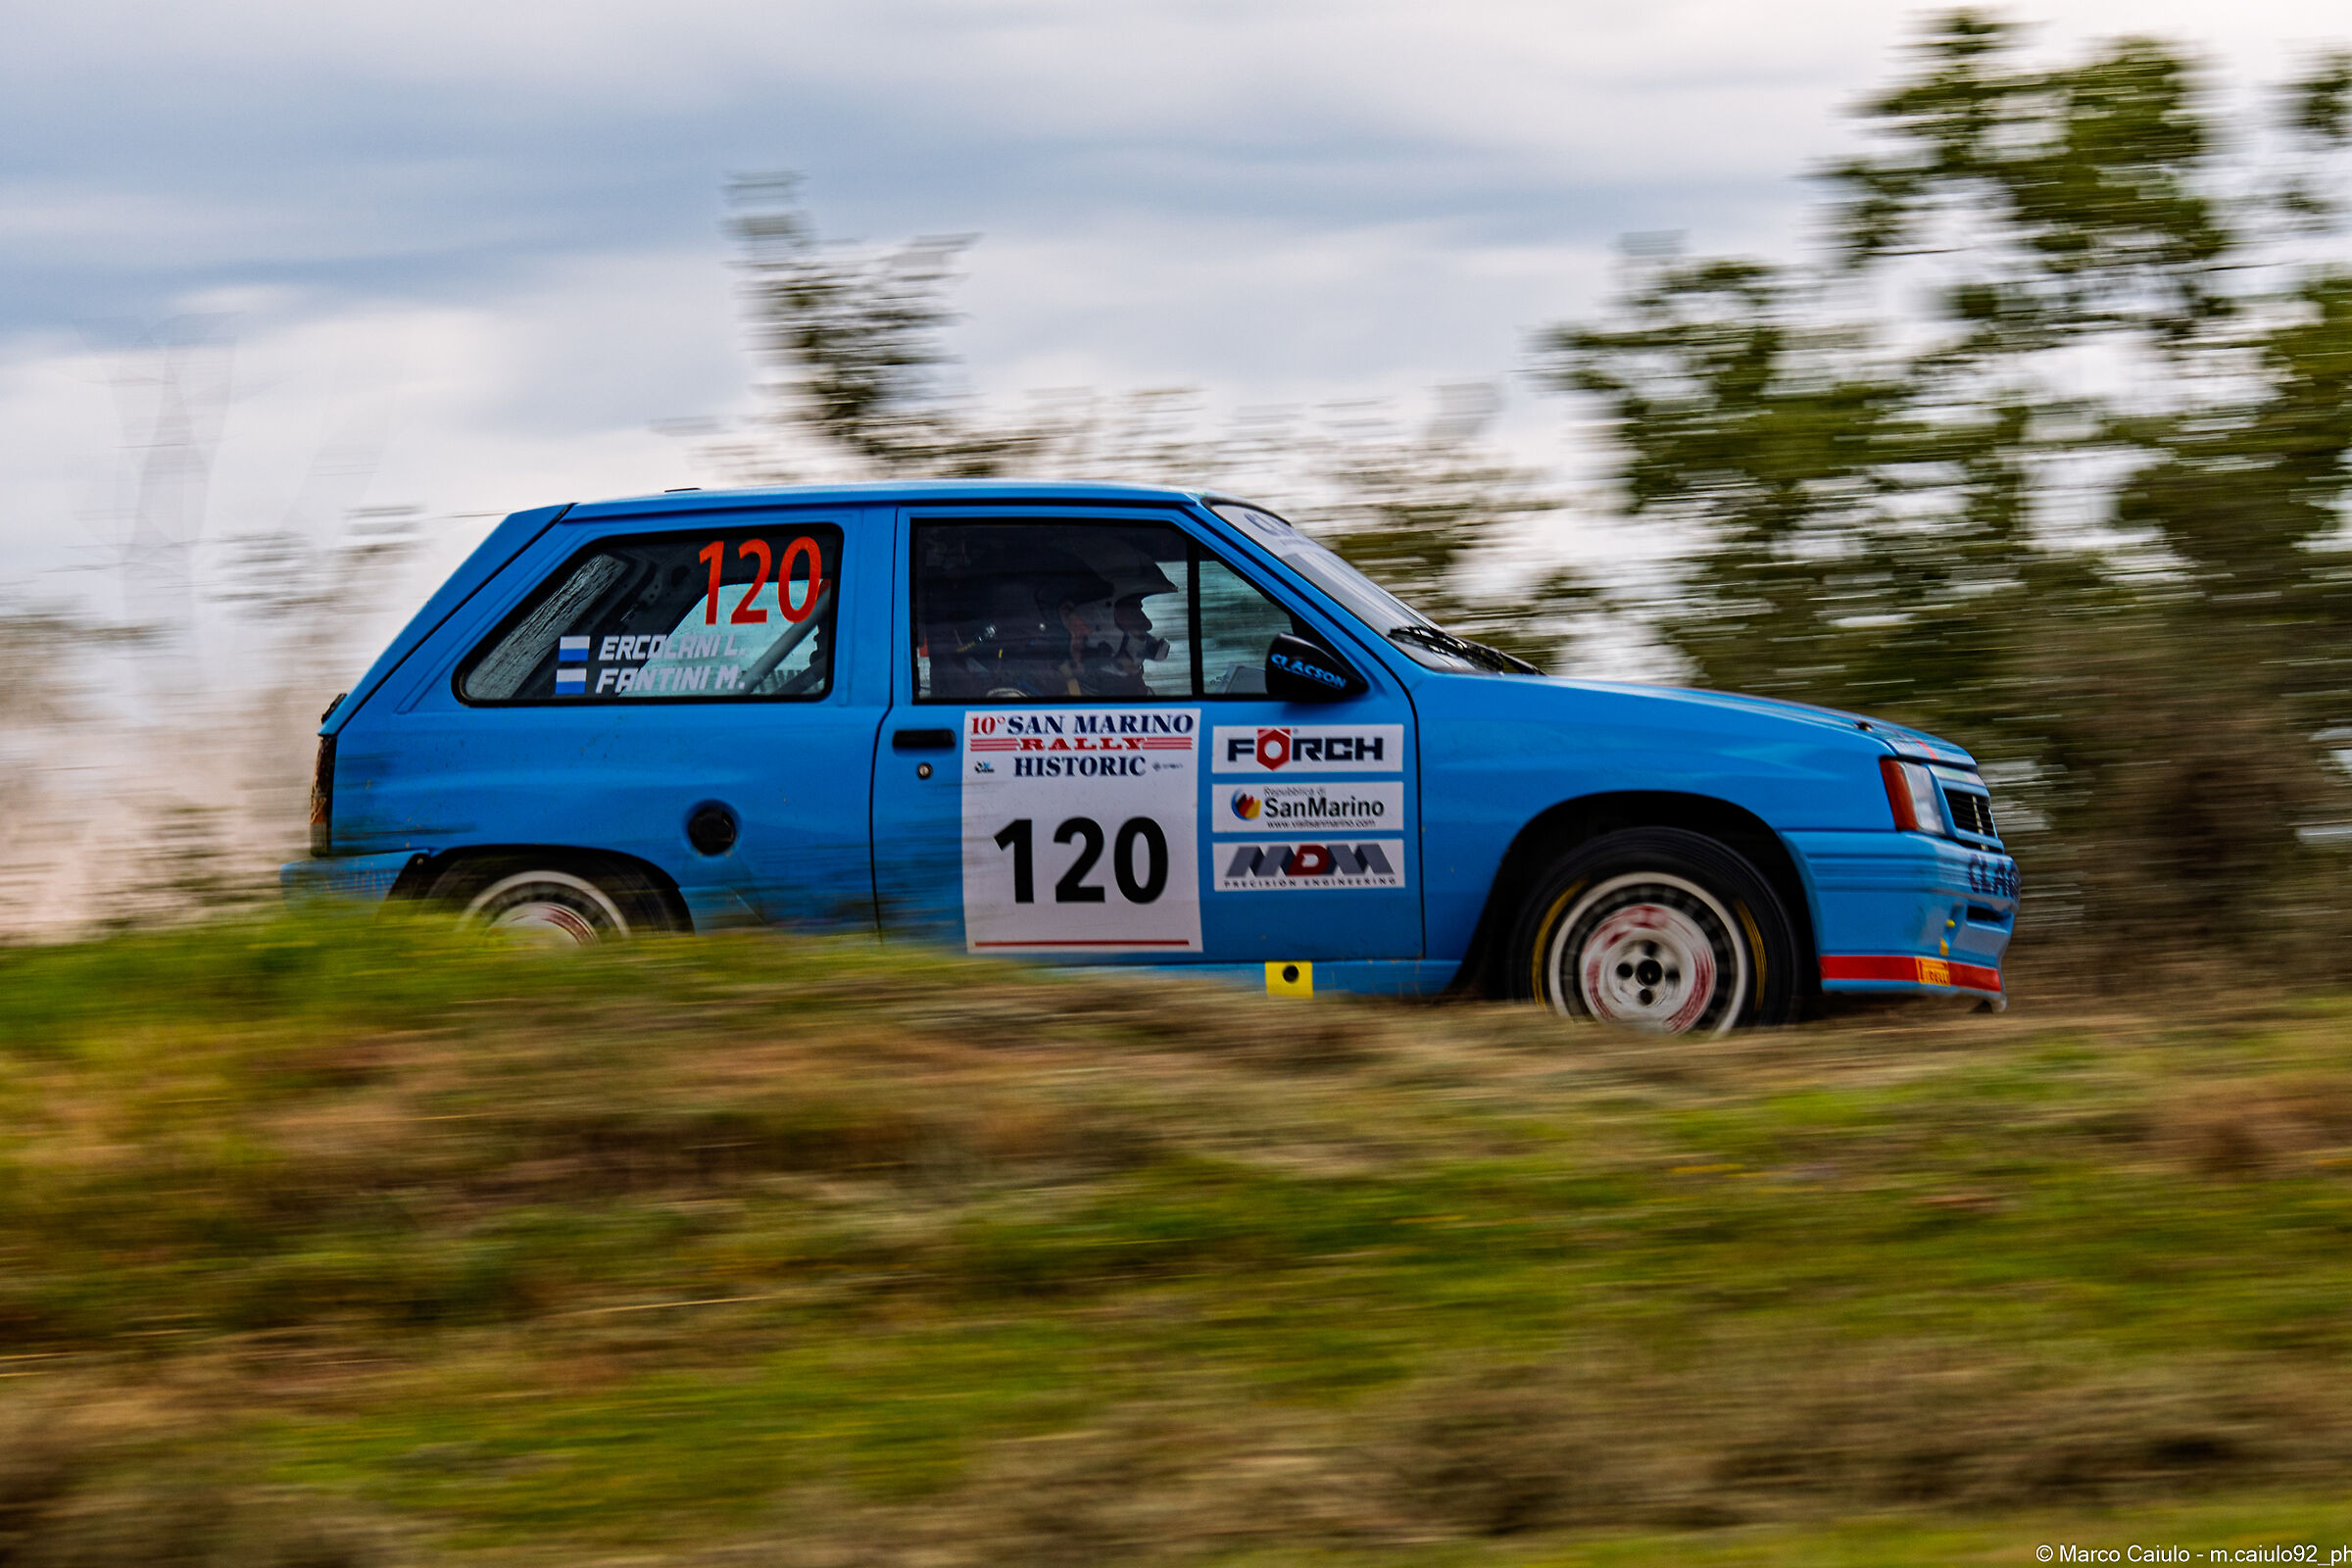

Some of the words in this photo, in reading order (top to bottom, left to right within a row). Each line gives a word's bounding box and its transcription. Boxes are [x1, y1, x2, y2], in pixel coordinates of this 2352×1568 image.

[699, 536, 822, 625] 120
[598, 634, 721, 662] ERCOLANI
[723, 634, 746, 658] L.
[595, 666, 712, 694] FANTINI
[714, 664, 746, 690] M.
[1271, 653, 1347, 690] CLACSON
[1006, 714, 1066, 735] SAN
[1074, 713, 1194, 734] MARINO
[1018, 737, 1146, 752] RALLY
[1013, 757, 1146, 777] HISTORIC
[1264, 796, 1385, 818] SanMarino
[994, 816, 1168, 905] 120
[1226, 844, 1396, 877] MDM
